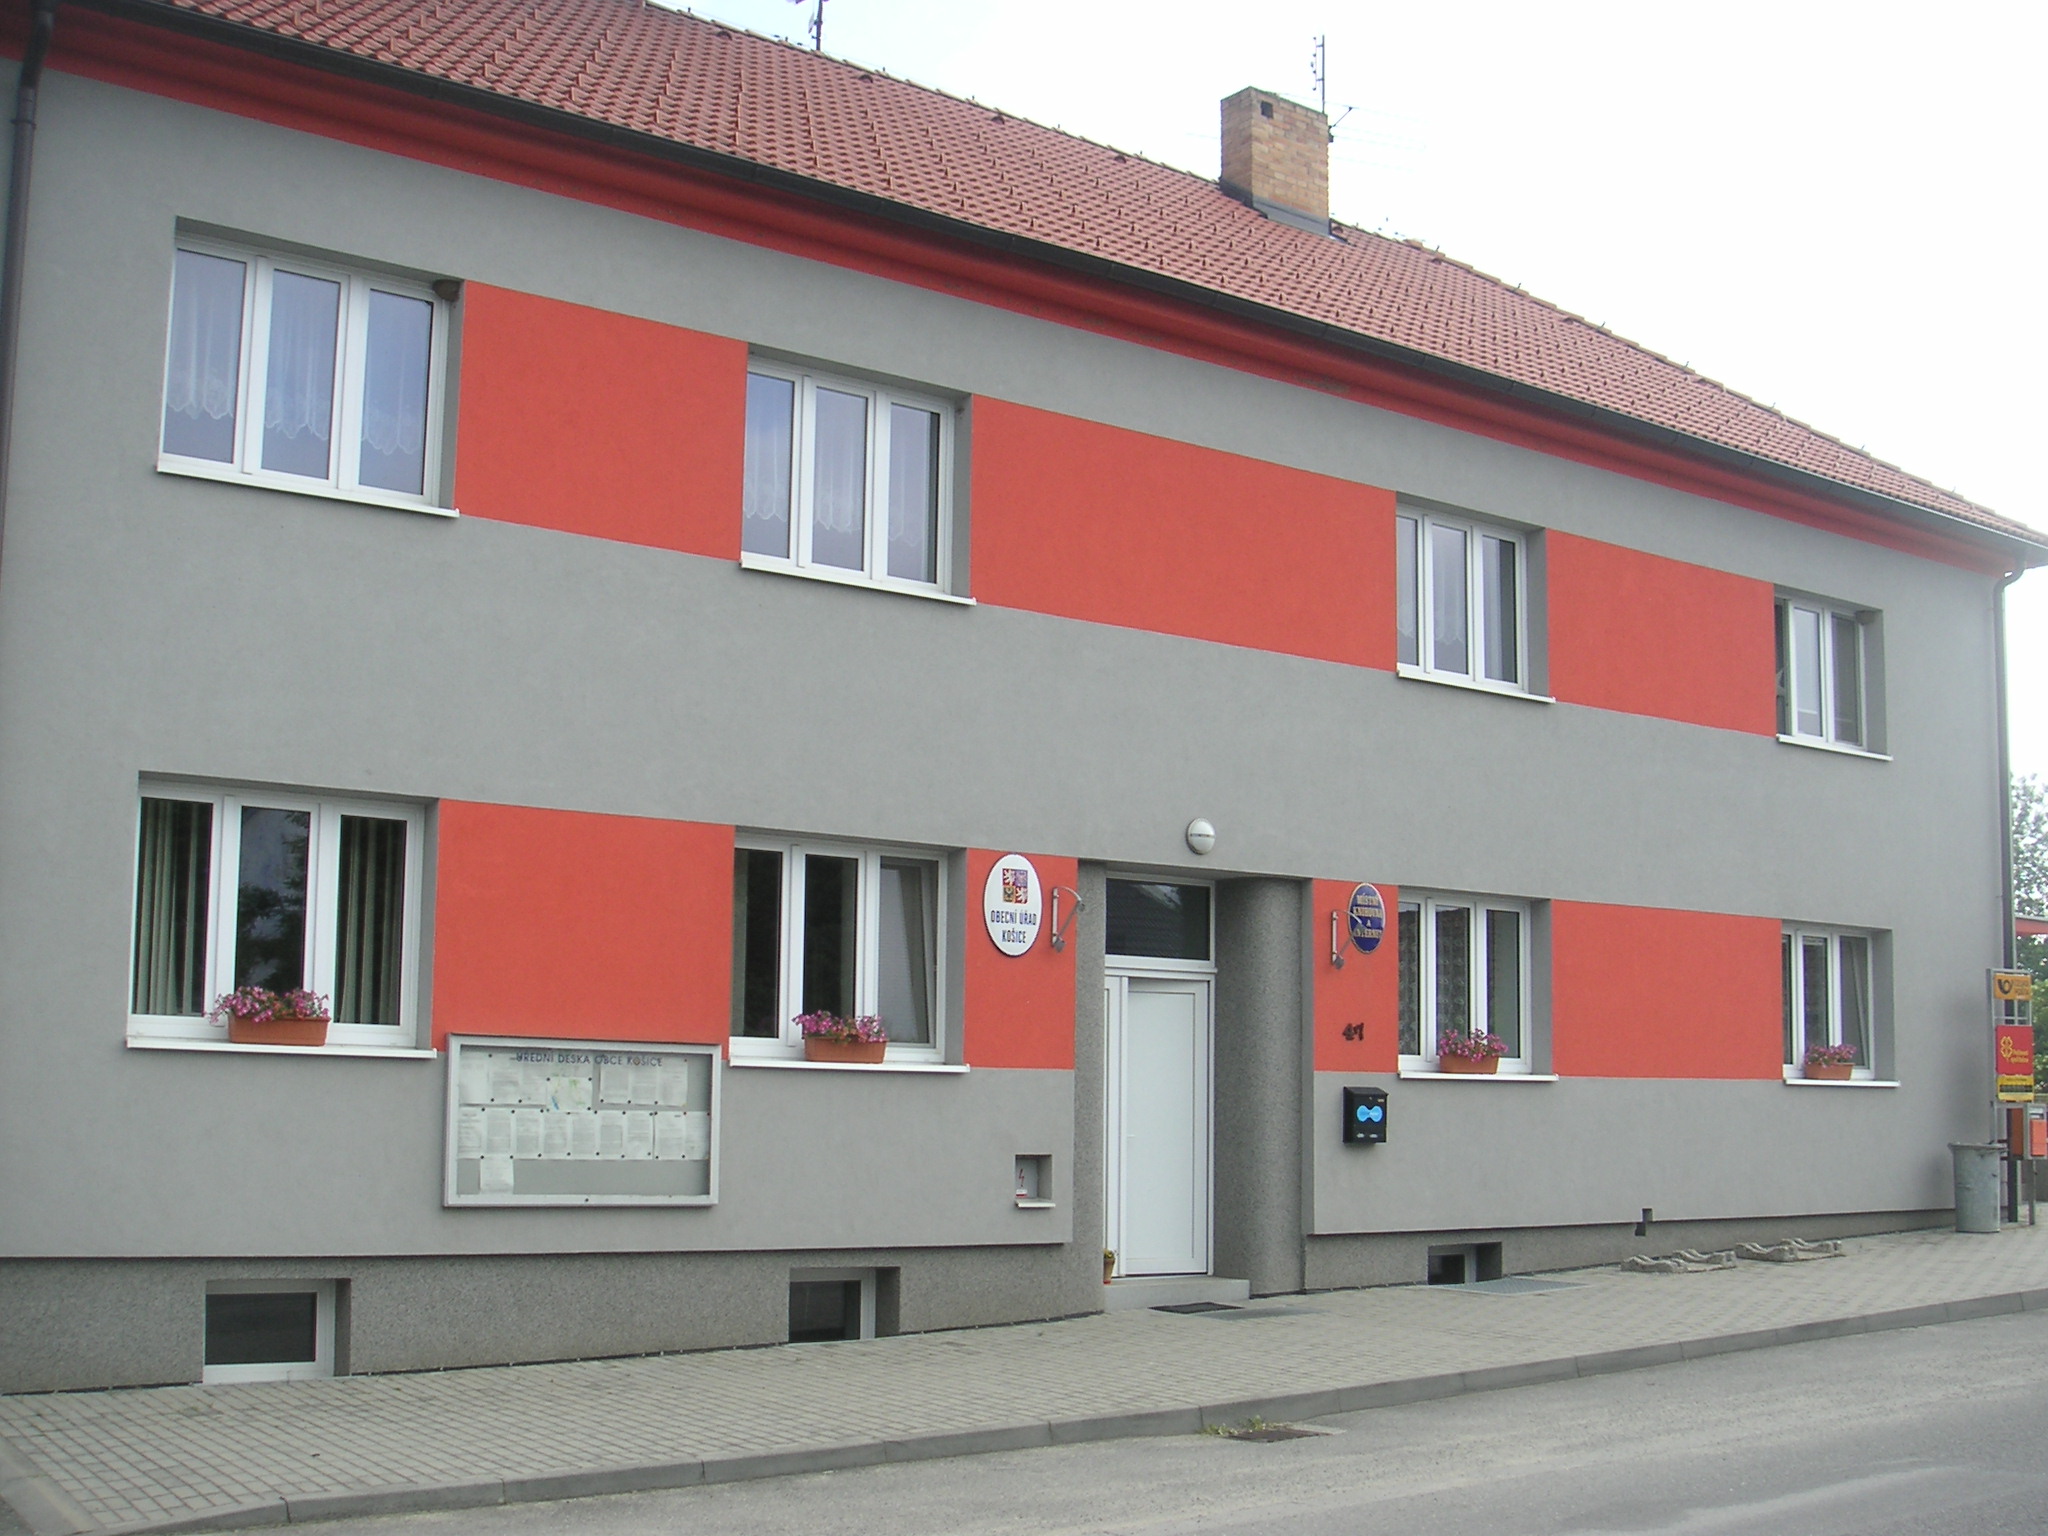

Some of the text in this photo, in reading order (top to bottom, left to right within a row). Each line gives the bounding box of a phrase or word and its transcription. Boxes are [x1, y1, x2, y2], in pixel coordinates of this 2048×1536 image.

[991, 909, 1037, 926] OBECNÍ ÚŘAD
[1002, 928, 1026, 943] KOŠICE
[558, 1053, 590, 1064] DESKA
[595, 1054, 623, 1065] OBCE
